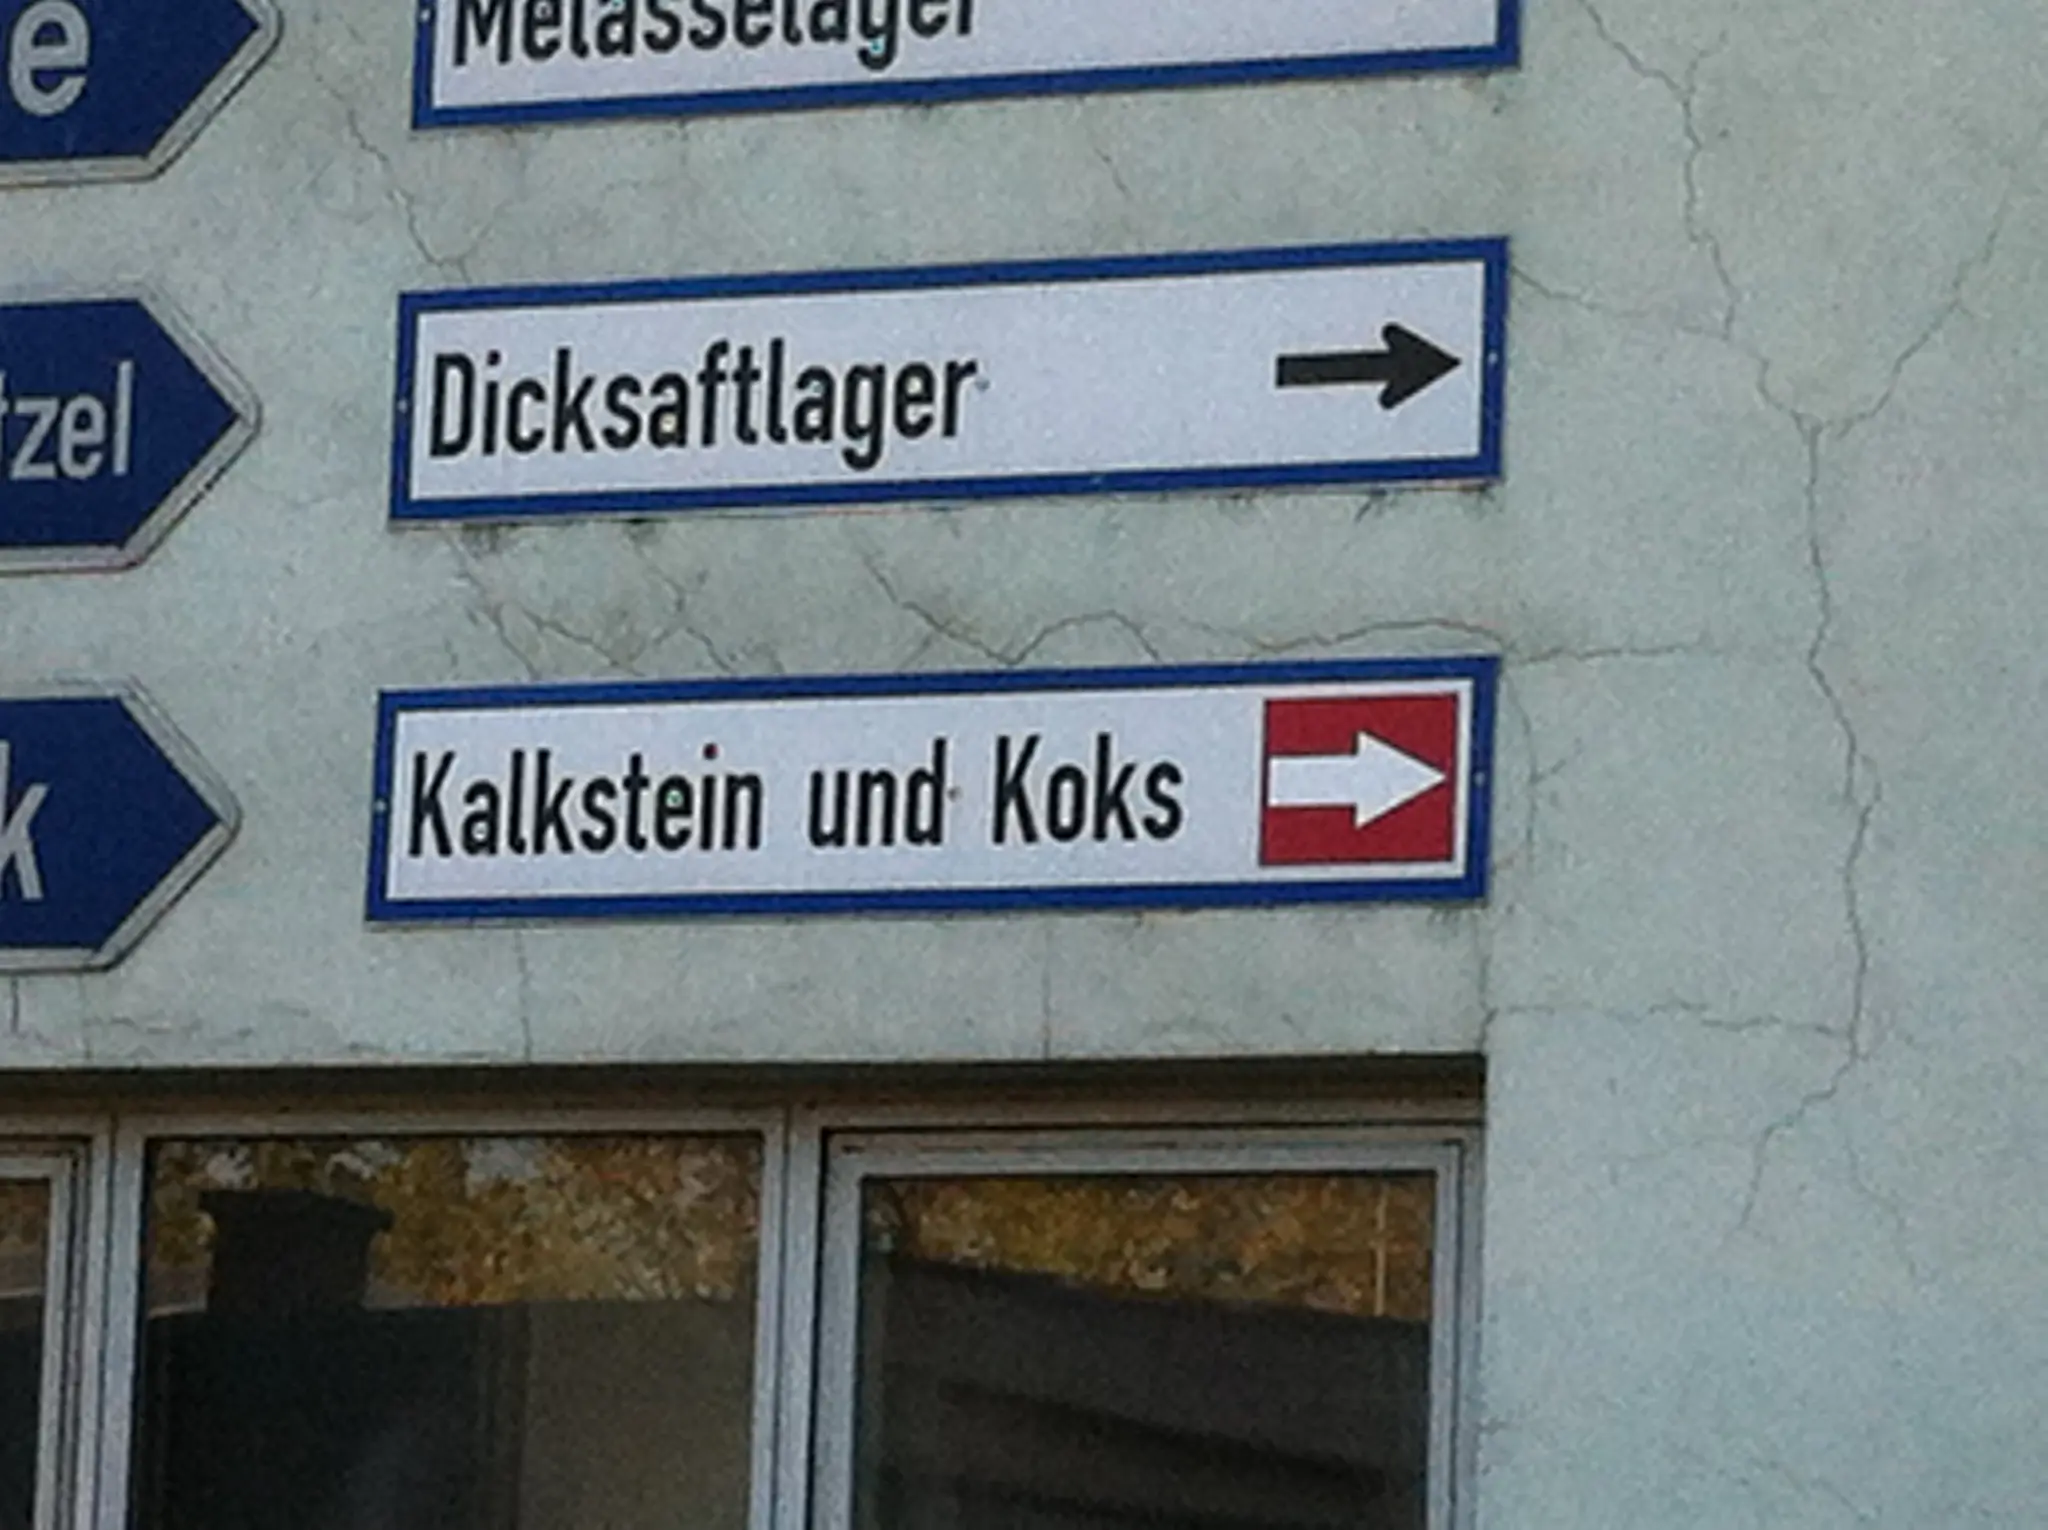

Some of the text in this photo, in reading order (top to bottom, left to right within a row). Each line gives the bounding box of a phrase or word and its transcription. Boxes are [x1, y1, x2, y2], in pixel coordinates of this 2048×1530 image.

[428, 337, 979, 472] Dicksaftlager
[407, 732, 1183, 858] Kalkstein und Koks
